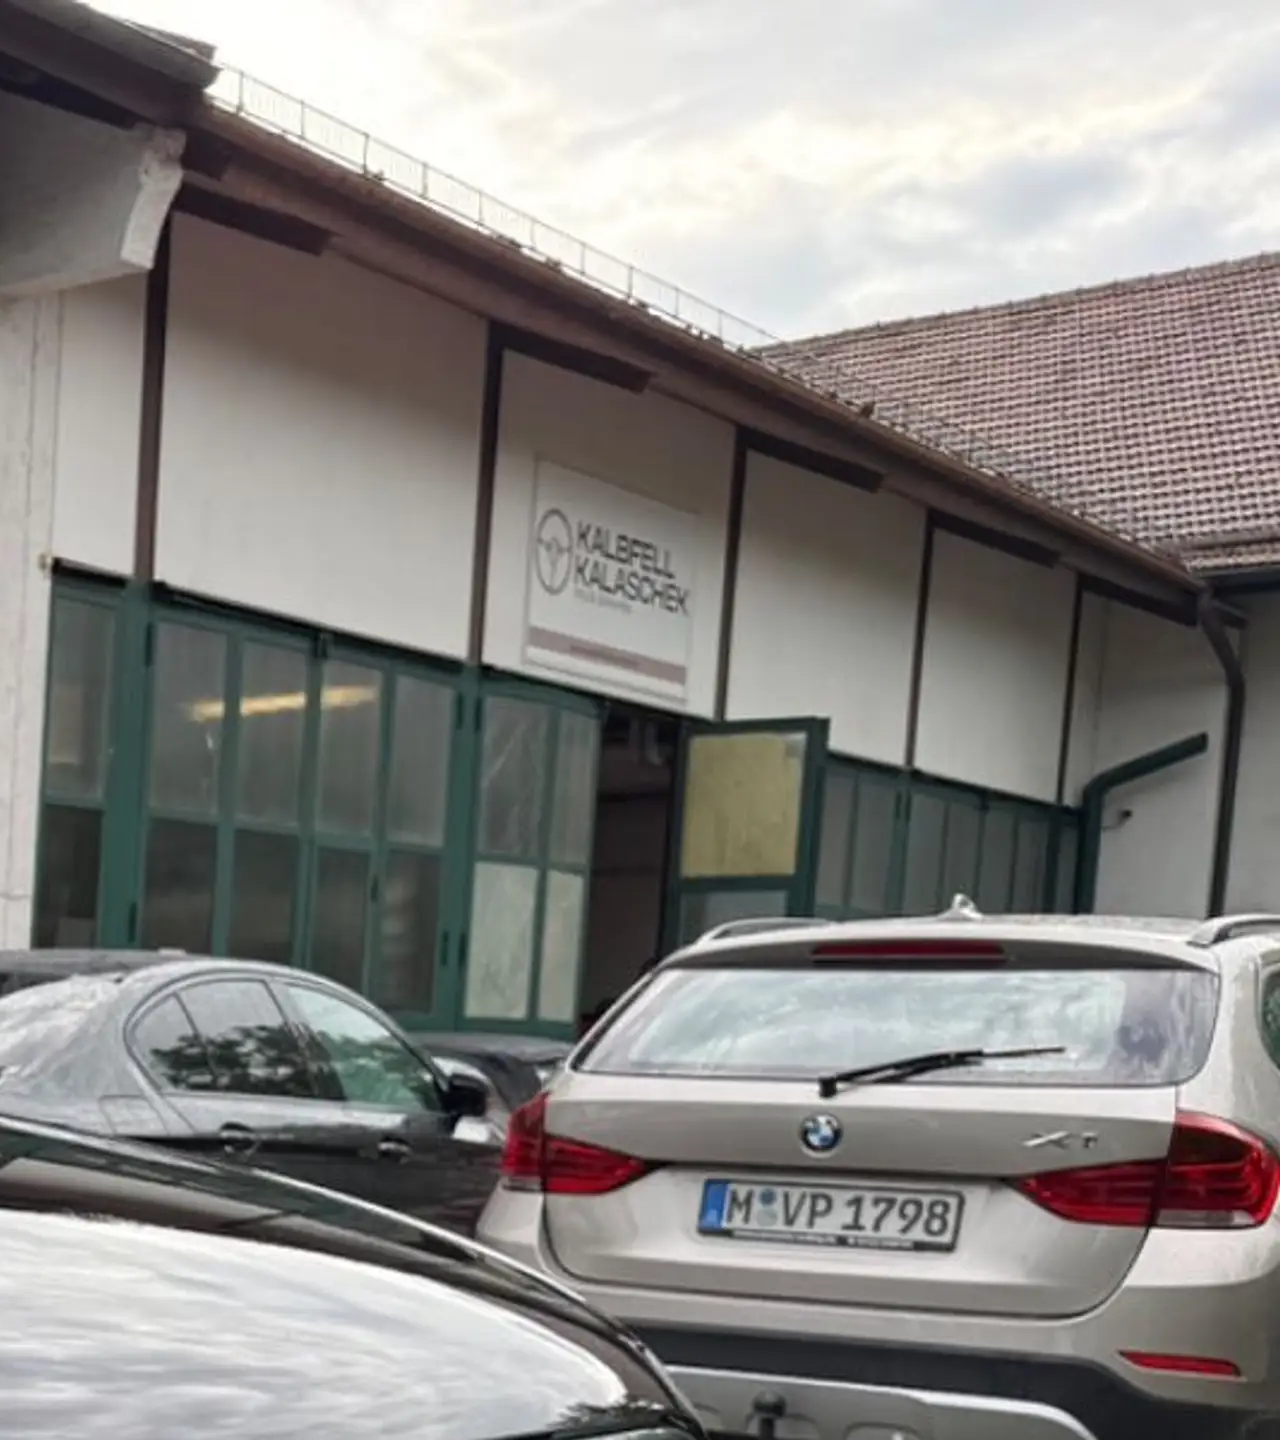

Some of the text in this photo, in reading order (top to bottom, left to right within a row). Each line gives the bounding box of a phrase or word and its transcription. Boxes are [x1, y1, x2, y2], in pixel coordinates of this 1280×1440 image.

[576, 520, 676, 580] KALBFELL
[574, 554, 690, 616] KALASCHEK
[727, 1188, 755, 1225] M
[782, 1190, 834, 1229] VP
[841, 1195, 951, 1238] 1798
